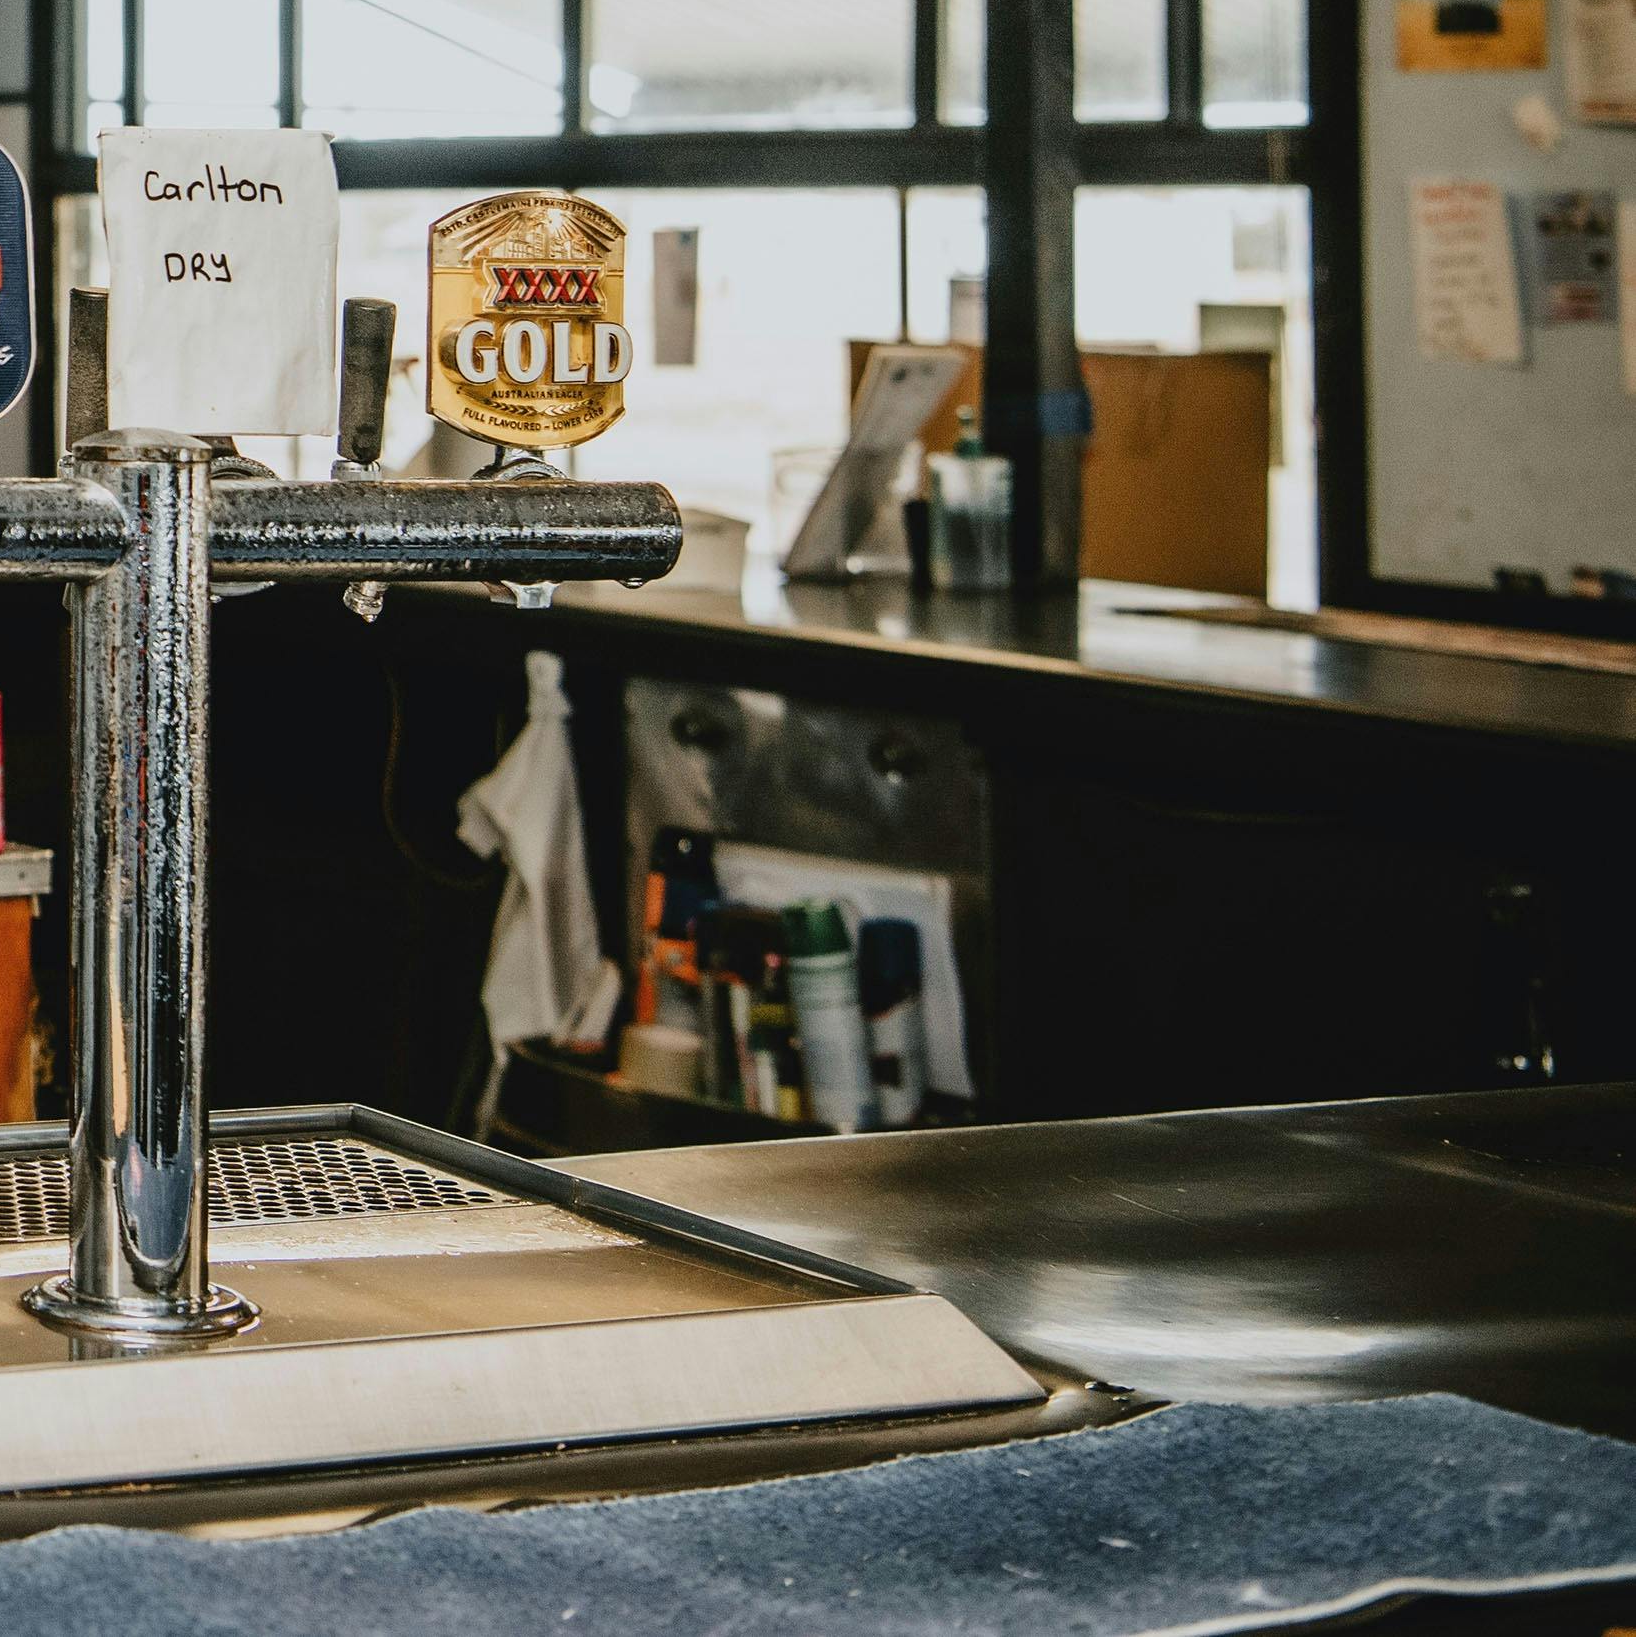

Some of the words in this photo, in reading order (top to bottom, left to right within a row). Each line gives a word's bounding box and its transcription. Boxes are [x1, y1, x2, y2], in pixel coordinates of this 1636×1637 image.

[144, 165, 283, 204] Carlton
[164, 252, 233, 283] DRY
[494, 266, 599, 306] XXXX
[455, 319, 633, 385] GOLD
[491, 389, 554, 399] AUSTRALIAN
[555, 389, 584, 399] LAGER
[462, 407, 486, 423] FULL
[488, 415, 542, 431] FLAVOURED
[551, 417, 581, 431] LOWER
